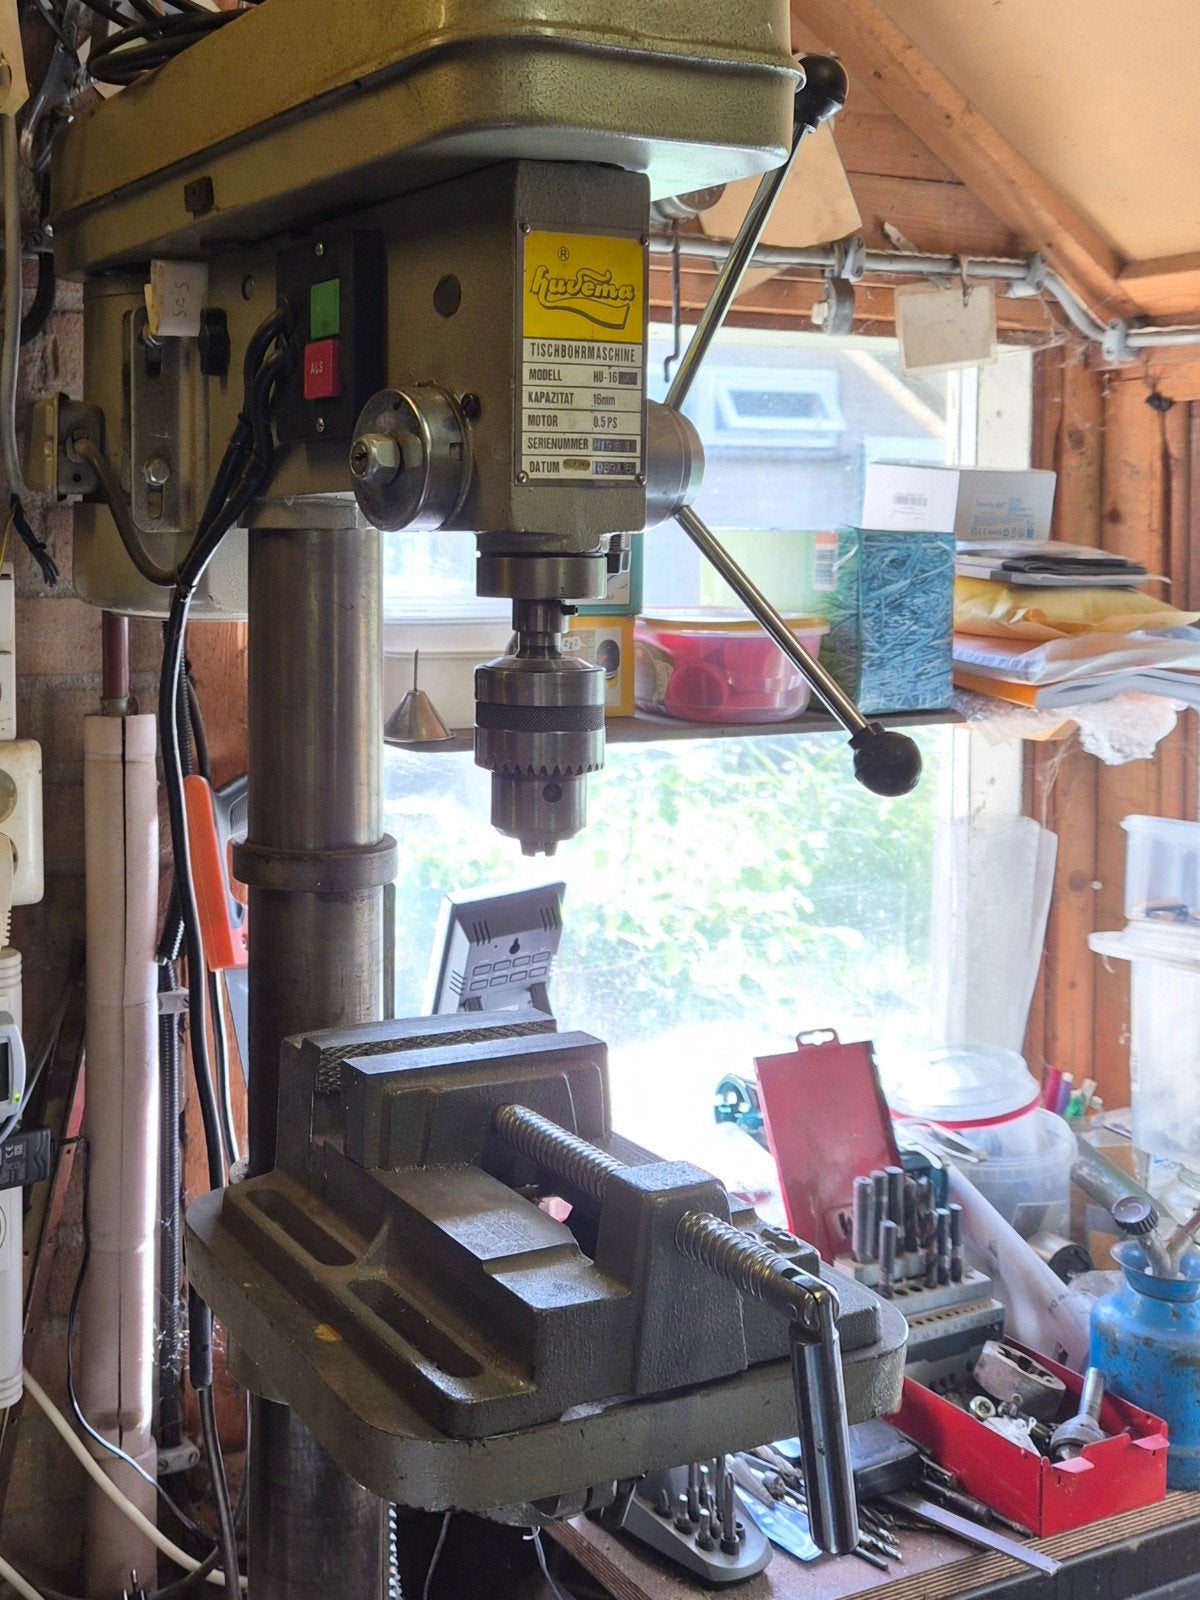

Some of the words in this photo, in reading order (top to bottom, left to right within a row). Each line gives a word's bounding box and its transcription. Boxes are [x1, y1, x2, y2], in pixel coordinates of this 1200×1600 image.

[530, 264, 636, 330] huvema
[530, 342, 635, 362] TISCHBOHRMASCHINE
[529, 368, 562, 381] MODELL
[528, 391, 574, 404] KAPAZITAT
[527, 414, 558, 427] MOTOR
[527, 437, 589, 450] SERIENUMMER
[529, 460, 560, 473] DATUM
